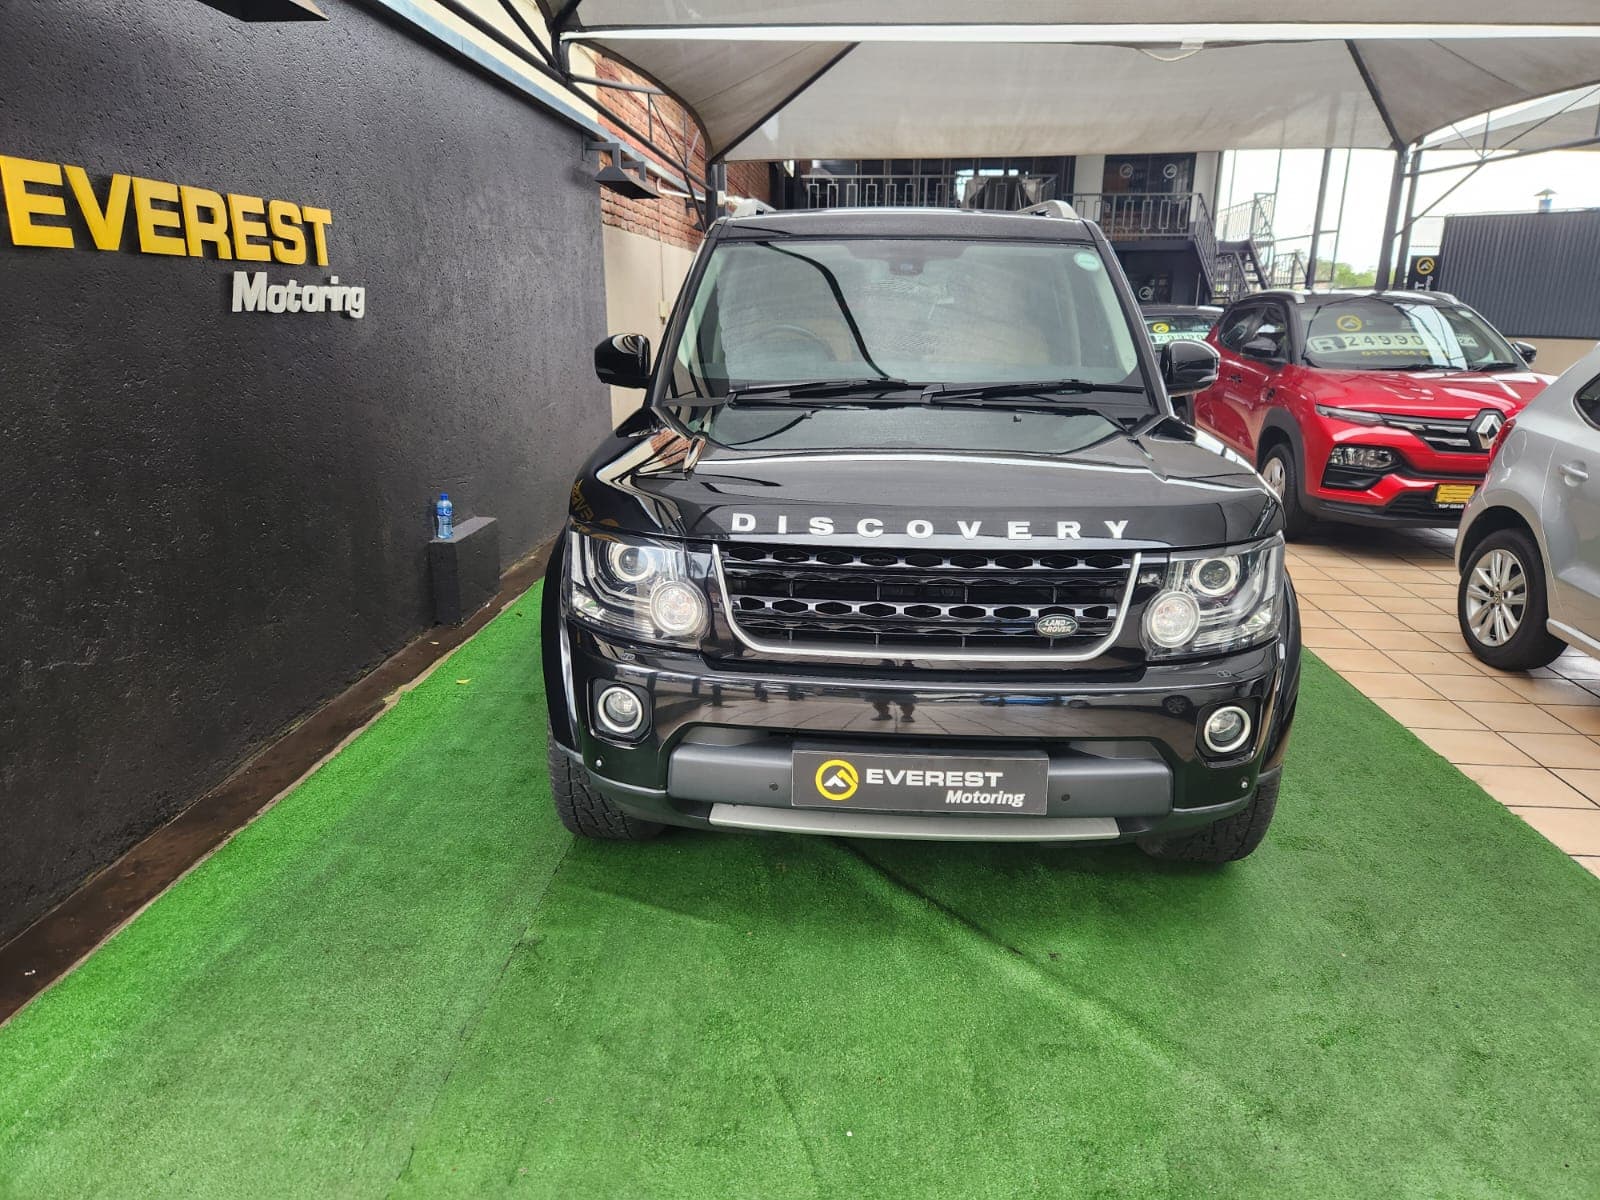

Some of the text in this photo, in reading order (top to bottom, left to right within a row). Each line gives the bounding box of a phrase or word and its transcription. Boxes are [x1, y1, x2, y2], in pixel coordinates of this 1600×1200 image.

[0, 155, 332, 266] EVEREST
[232, 271, 365, 319] Motoring
[732, 513, 1128, 540] DISCOVERY
[866, 769, 1003, 787] EVEREST
[946, 790, 1025, 807] Motoring
